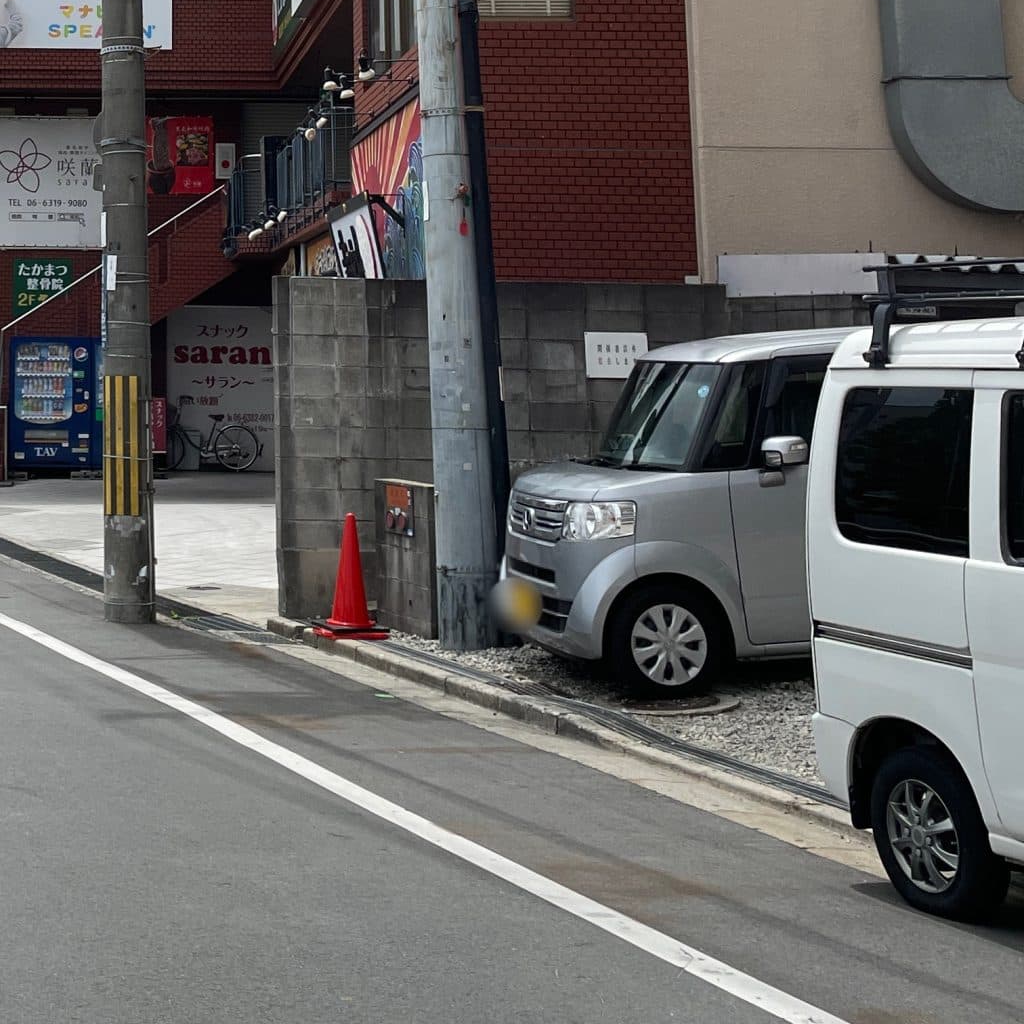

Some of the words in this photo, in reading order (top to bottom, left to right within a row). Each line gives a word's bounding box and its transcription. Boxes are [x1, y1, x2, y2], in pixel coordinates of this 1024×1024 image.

[8, 198, 22, 207] TEL
[18, 263, 68, 277] たかまつ
[26, 277, 64, 291] 整骨院
[17, 292, 37, 307] 2F
[196, 324, 249, 339] スナック
[174, 345, 271, 365] saran
